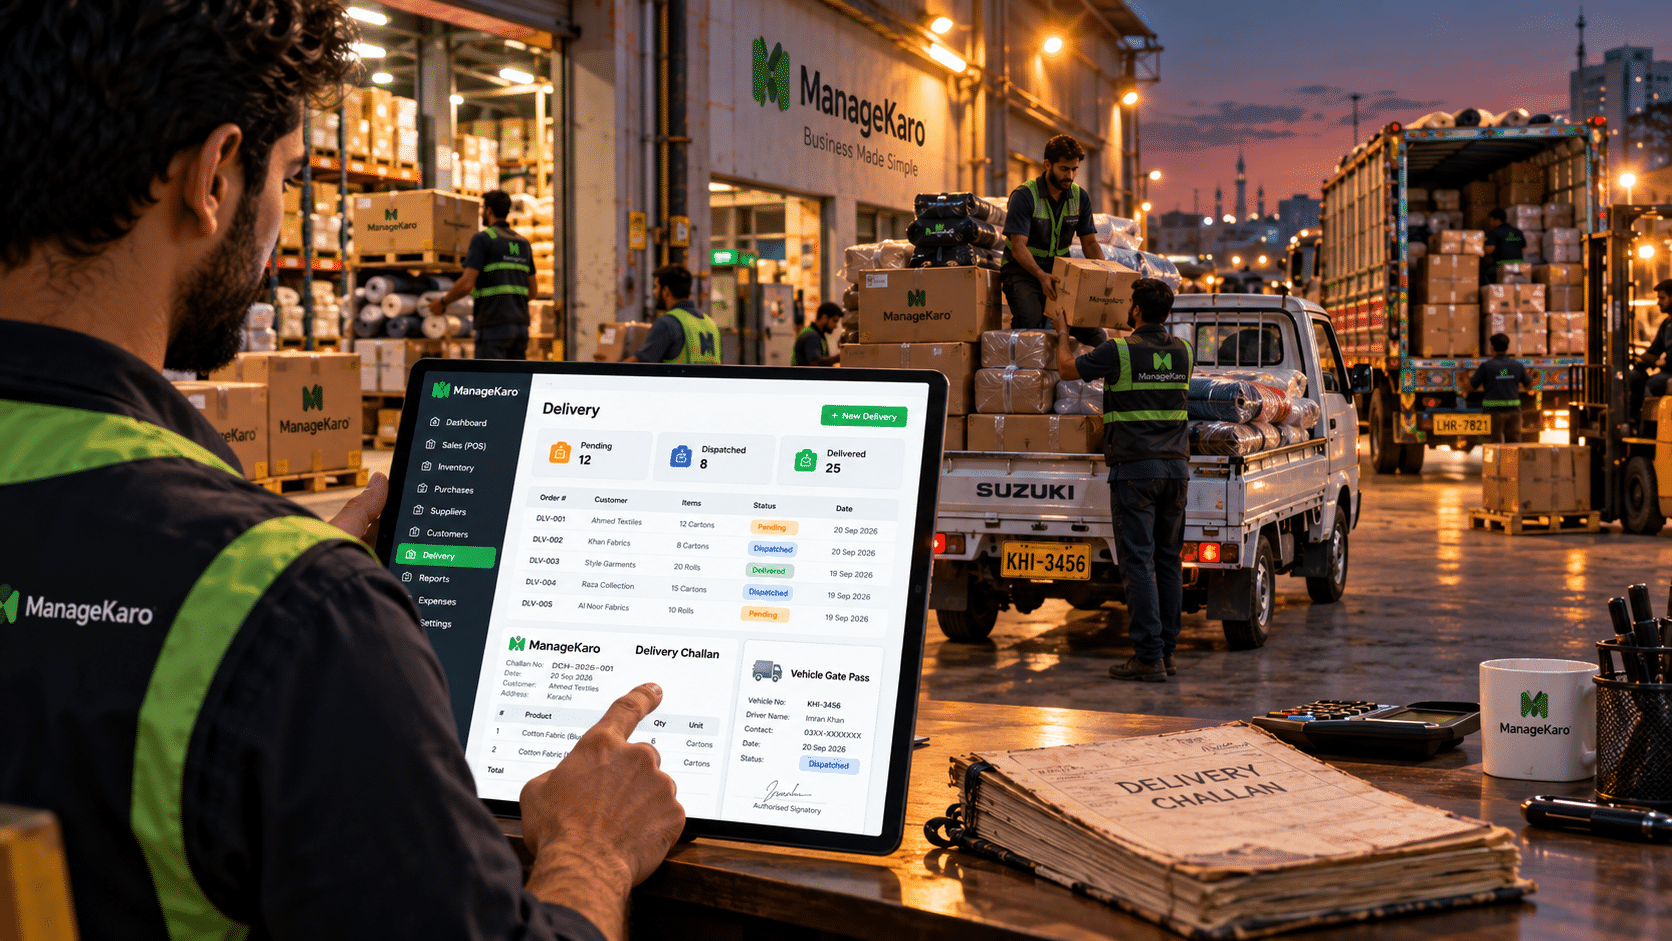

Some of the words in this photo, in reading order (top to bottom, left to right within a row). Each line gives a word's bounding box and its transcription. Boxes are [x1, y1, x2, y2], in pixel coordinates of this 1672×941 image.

[800, 64, 926, 147] ManageKaro
[803, 125, 853, 159] Business
[856, 143, 885, 168] Made
[887, 152, 919, 178] Simple
[367, 222, 418, 232] ManageKaro
[883, 310, 952, 324] ManageKaro
[1138, 372, 1187, 382] ManageKaro
[454, 386, 518, 398] ManageKaro
[543, 402, 600, 418] Delivery
[863, 413, 897, 422] Delivery
[279, 417, 350, 436] ManageKaro
[446, 419, 487, 427] Dashboard
[1436, 419, 1488, 431] LHR-7821
[465, 442, 486, 451] (POS)
[581, 442, 612, 451] Pending
[702, 446, 746, 454] Dispatched
[827, 449, 866, 458] Delivered
[579, 455, 591, 465] 12
[700, 459, 707, 469] 8
[438, 463, 474, 473] Inventory
[826, 463, 840, 473] 25
[435, 485, 473, 494] Purchases
[976, 483, 1074, 500] SUZUKI
[431, 507, 466, 516] Suppliers
[591, 517, 616, 525] Ahmed
[617, 518, 643, 526] Textiles
[758, 524, 786, 532] Pending
[845, 527, 858, 535] Sep
[860, 527, 878, 535] 2026
[427, 529, 468, 538] Customers
[754, 545, 793, 553] Dispatched
[842, 549, 855, 557] Sep
[423, 551, 455, 561] Delivery
[1006, 551, 1086, 573] KHI-3456
[419, 574, 449, 583] Reports
[526, 578, 556, 586] DLV-004
[680, 585, 707, 593] Cartons
[749, 588, 788, 597] Dispatched
[837, 592, 850, 601] Sep
[419, 597, 456, 606] Expenses
[25, 595, 153, 627] ManageKaro
[749, 610, 777, 620] Pending
[835, 614, 848, 622] Sep
[421, 619, 451, 629] Settings
[529, 640, 600, 654] ManageKaro
[636, 645, 678, 658] Delivery
[681, 648, 719, 658] Challan
[791, 670, 823, 679] Vehicle
[825, 671, 846, 681] Gate
[849, 673, 869, 682] Pass
[748, 697, 773, 705] Vehicle
[525, 711, 552, 719] Product
[744, 725, 773, 733] Contact:
[1500, 722, 1570, 737] ManageKaro
[686, 740, 713, 748] Cartons
[813, 744, 826, 752] Sep
[828, 745, 846, 753] 2026
[518, 748, 541, 756] Cotton
[542, 750, 562, 758] Fabric
[684, 759, 710, 767] Cartons
[740, 755, 764, 763] Status:
[809, 759, 849, 769] Dispatched
[1114, 764, 1261, 795] DELIVERY
[1150, 781, 1288, 810] CHALLAN
[753, 801, 789, 811] Authorised
[790, 805, 821, 815] Signatory
